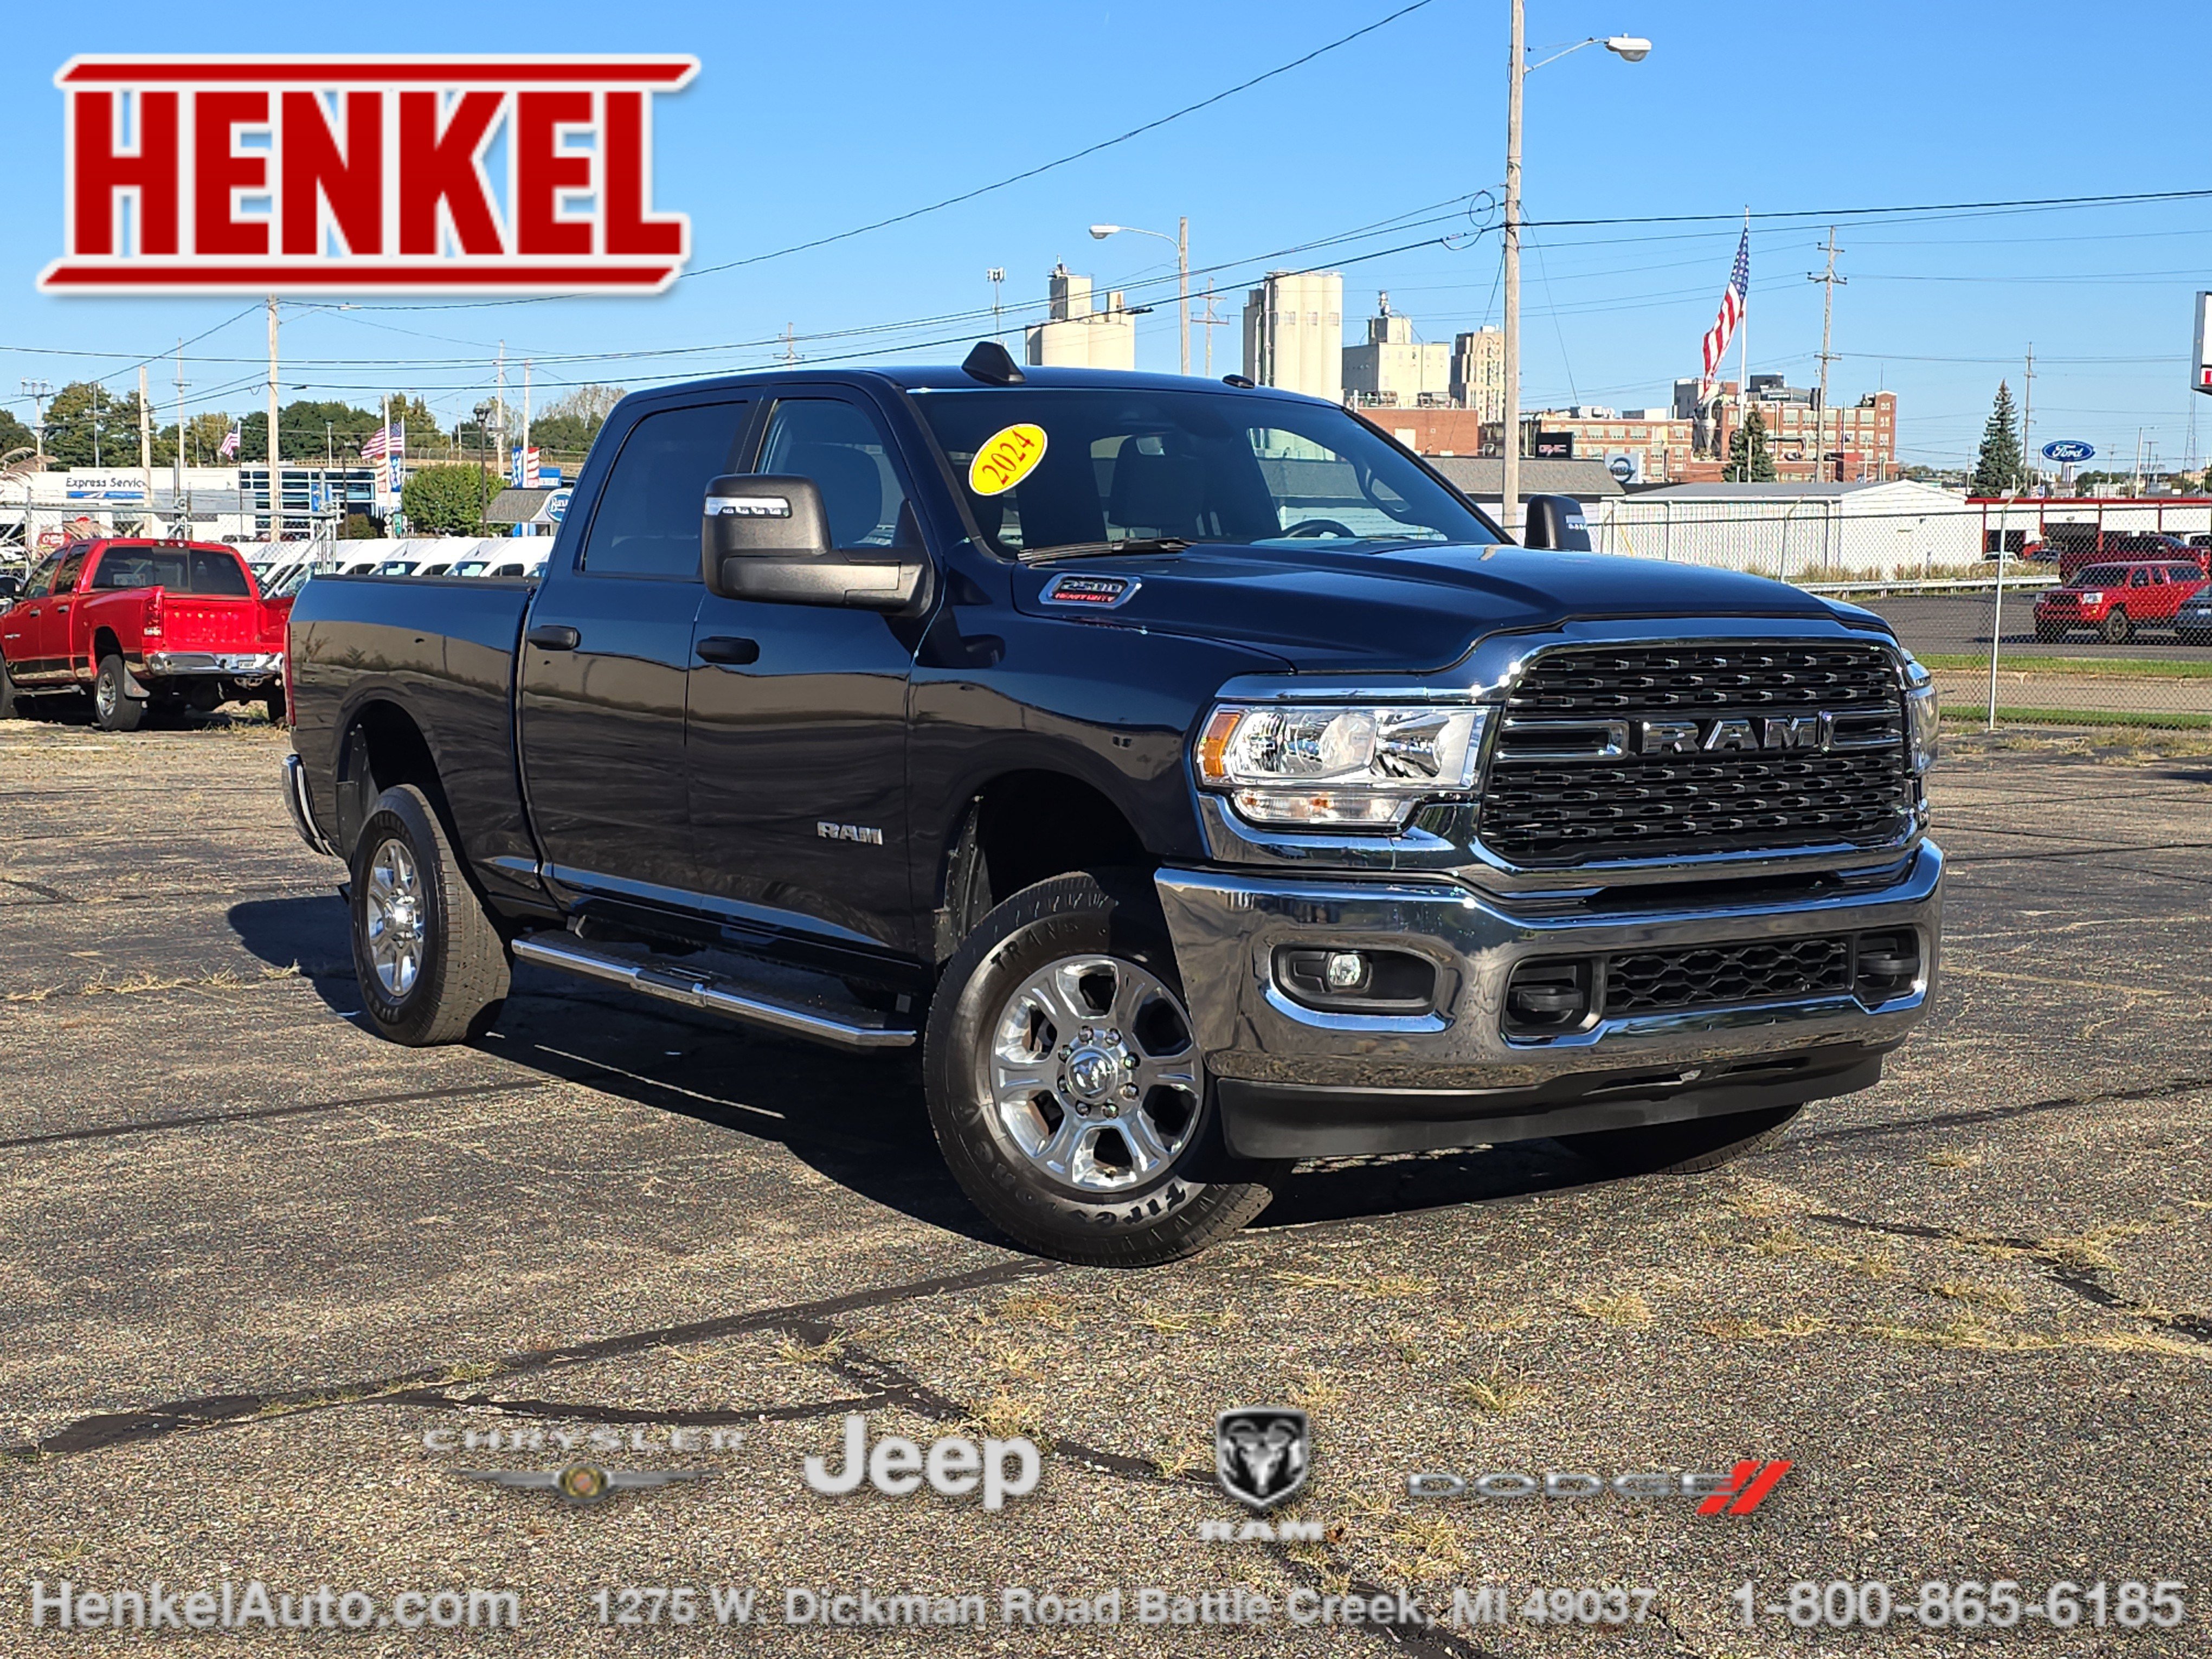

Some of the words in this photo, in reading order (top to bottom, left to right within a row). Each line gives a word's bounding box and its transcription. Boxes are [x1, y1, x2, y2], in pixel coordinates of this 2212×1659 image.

[982, 429, 1035, 486] 2024
[2052, 445, 2084, 458] Ford
[66, 477, 106, 489] Express
[110, 477, 144, 487] Servic
[1060, 580, 1123, 593] 2500
[1642, 717, 1817, 754] RAM
[816, 821, 883, 845] RAM
